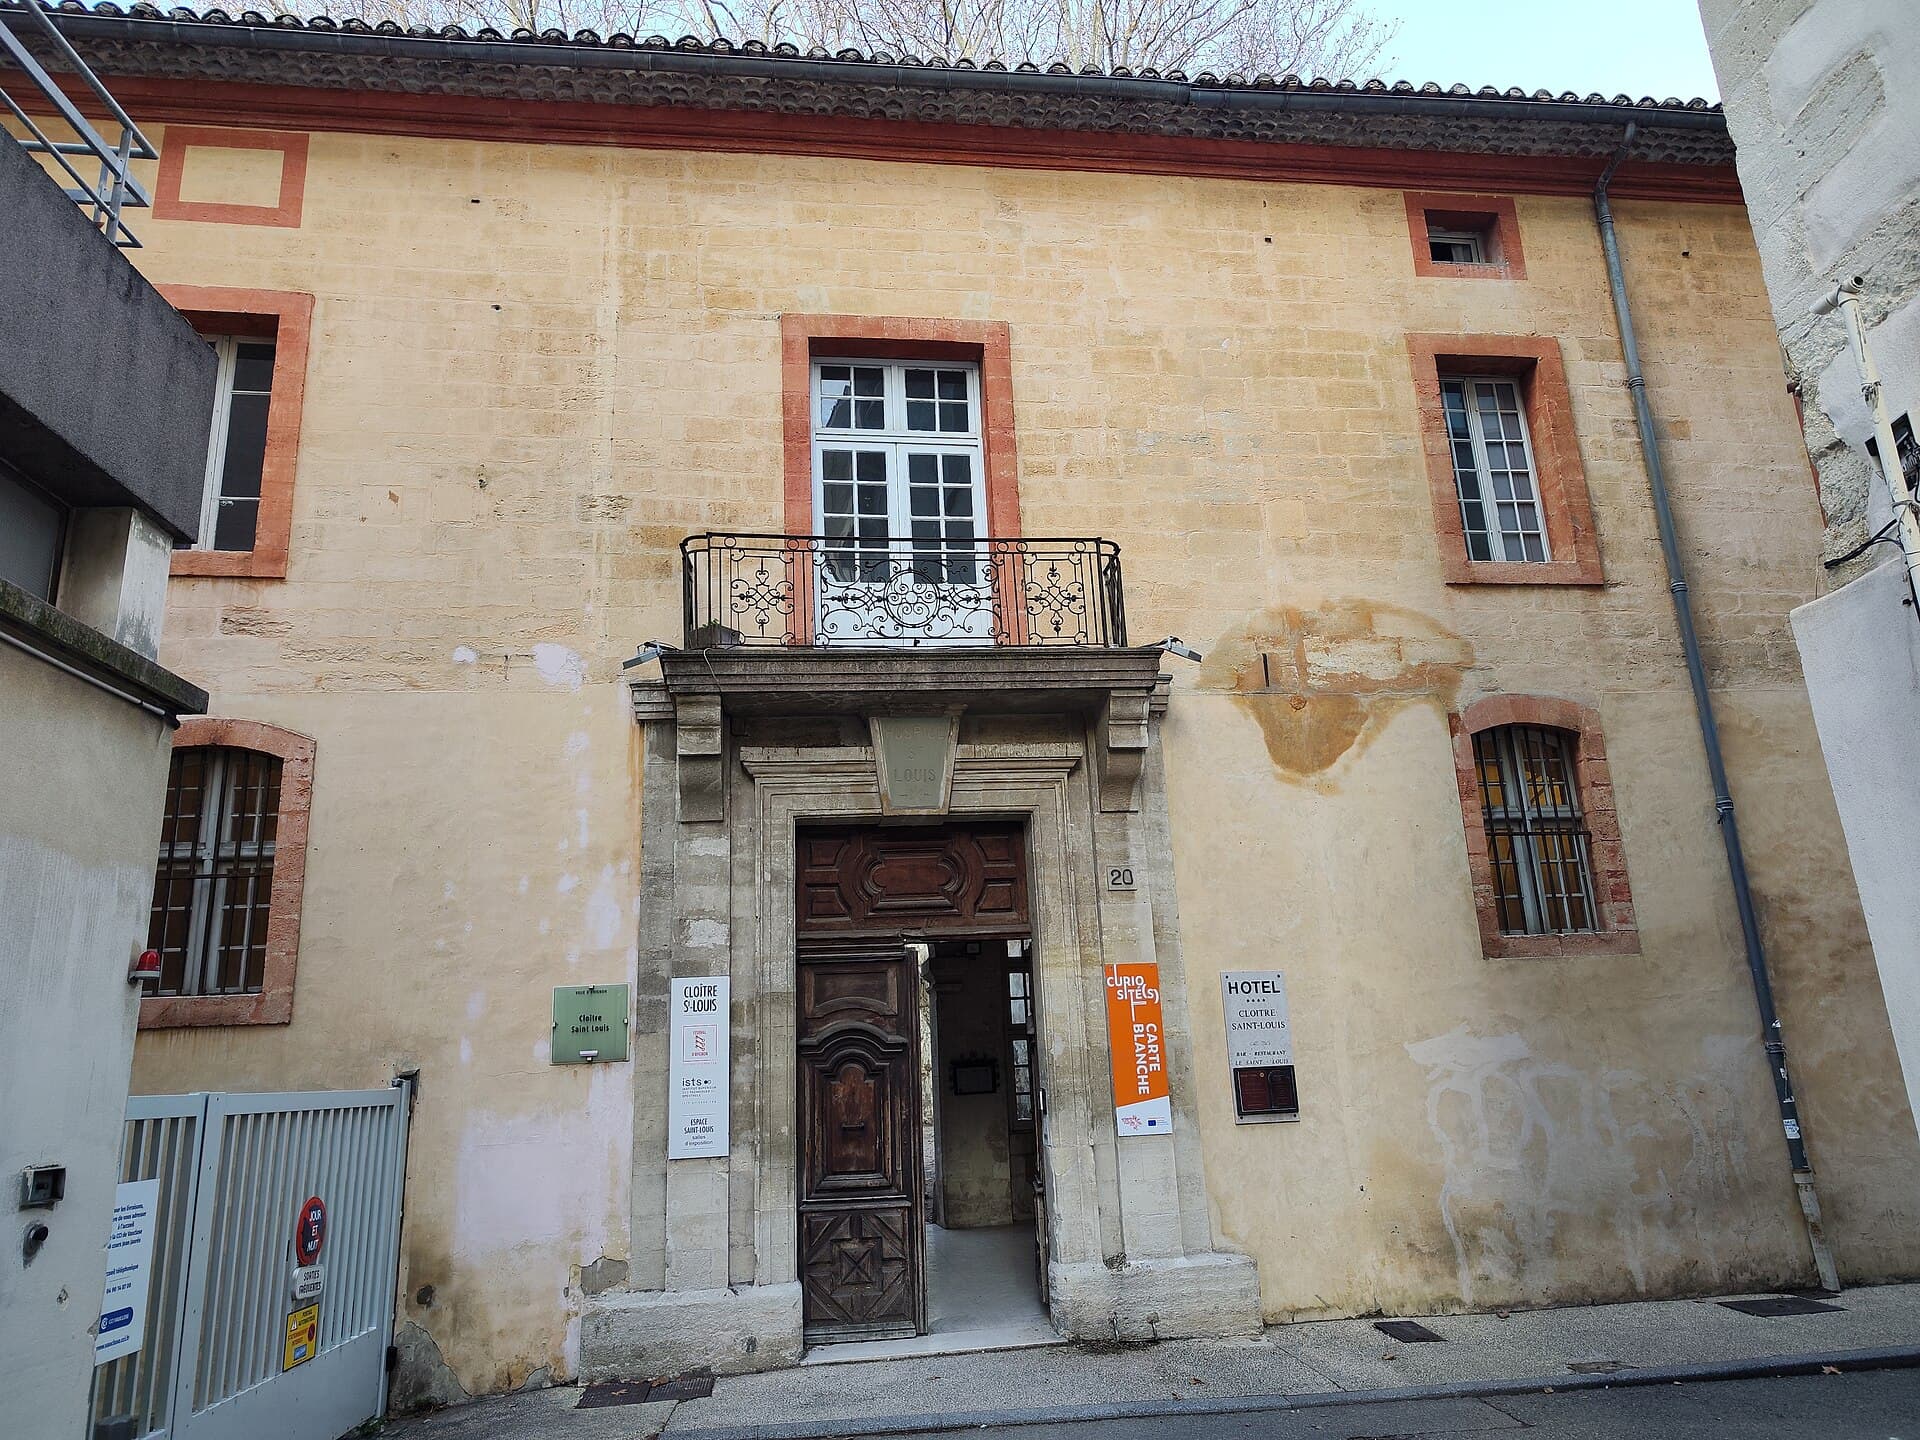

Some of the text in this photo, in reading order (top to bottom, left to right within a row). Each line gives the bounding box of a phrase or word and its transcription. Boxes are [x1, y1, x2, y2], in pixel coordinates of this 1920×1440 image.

[893, 768, 936, 783] LOUIS
[1110, 869, 1134, 886] 20
[1106, 970, 1144, 988] CURIO
[684, 983, 718, 998] CLOÎTRE
[1228, 980, 1281, 995] HOTEL
[571, 1023, 610, 1033] Saint Louis
[1231, 1021, 1286, 1031] SAINT-LOUIS
[1146, 1023, 1161, 1072] CARTE
[1133, 1023, 1150, 1095] BLANCHE
[682, 1077, 702, 1087] ists
[690, 1118, 708, 1126] ESPACE
[309, 1209, 322, 1222] JOUR
[311, 1224, 319, 1237] ET
[306, 1239, 319, 1253] NUIT
